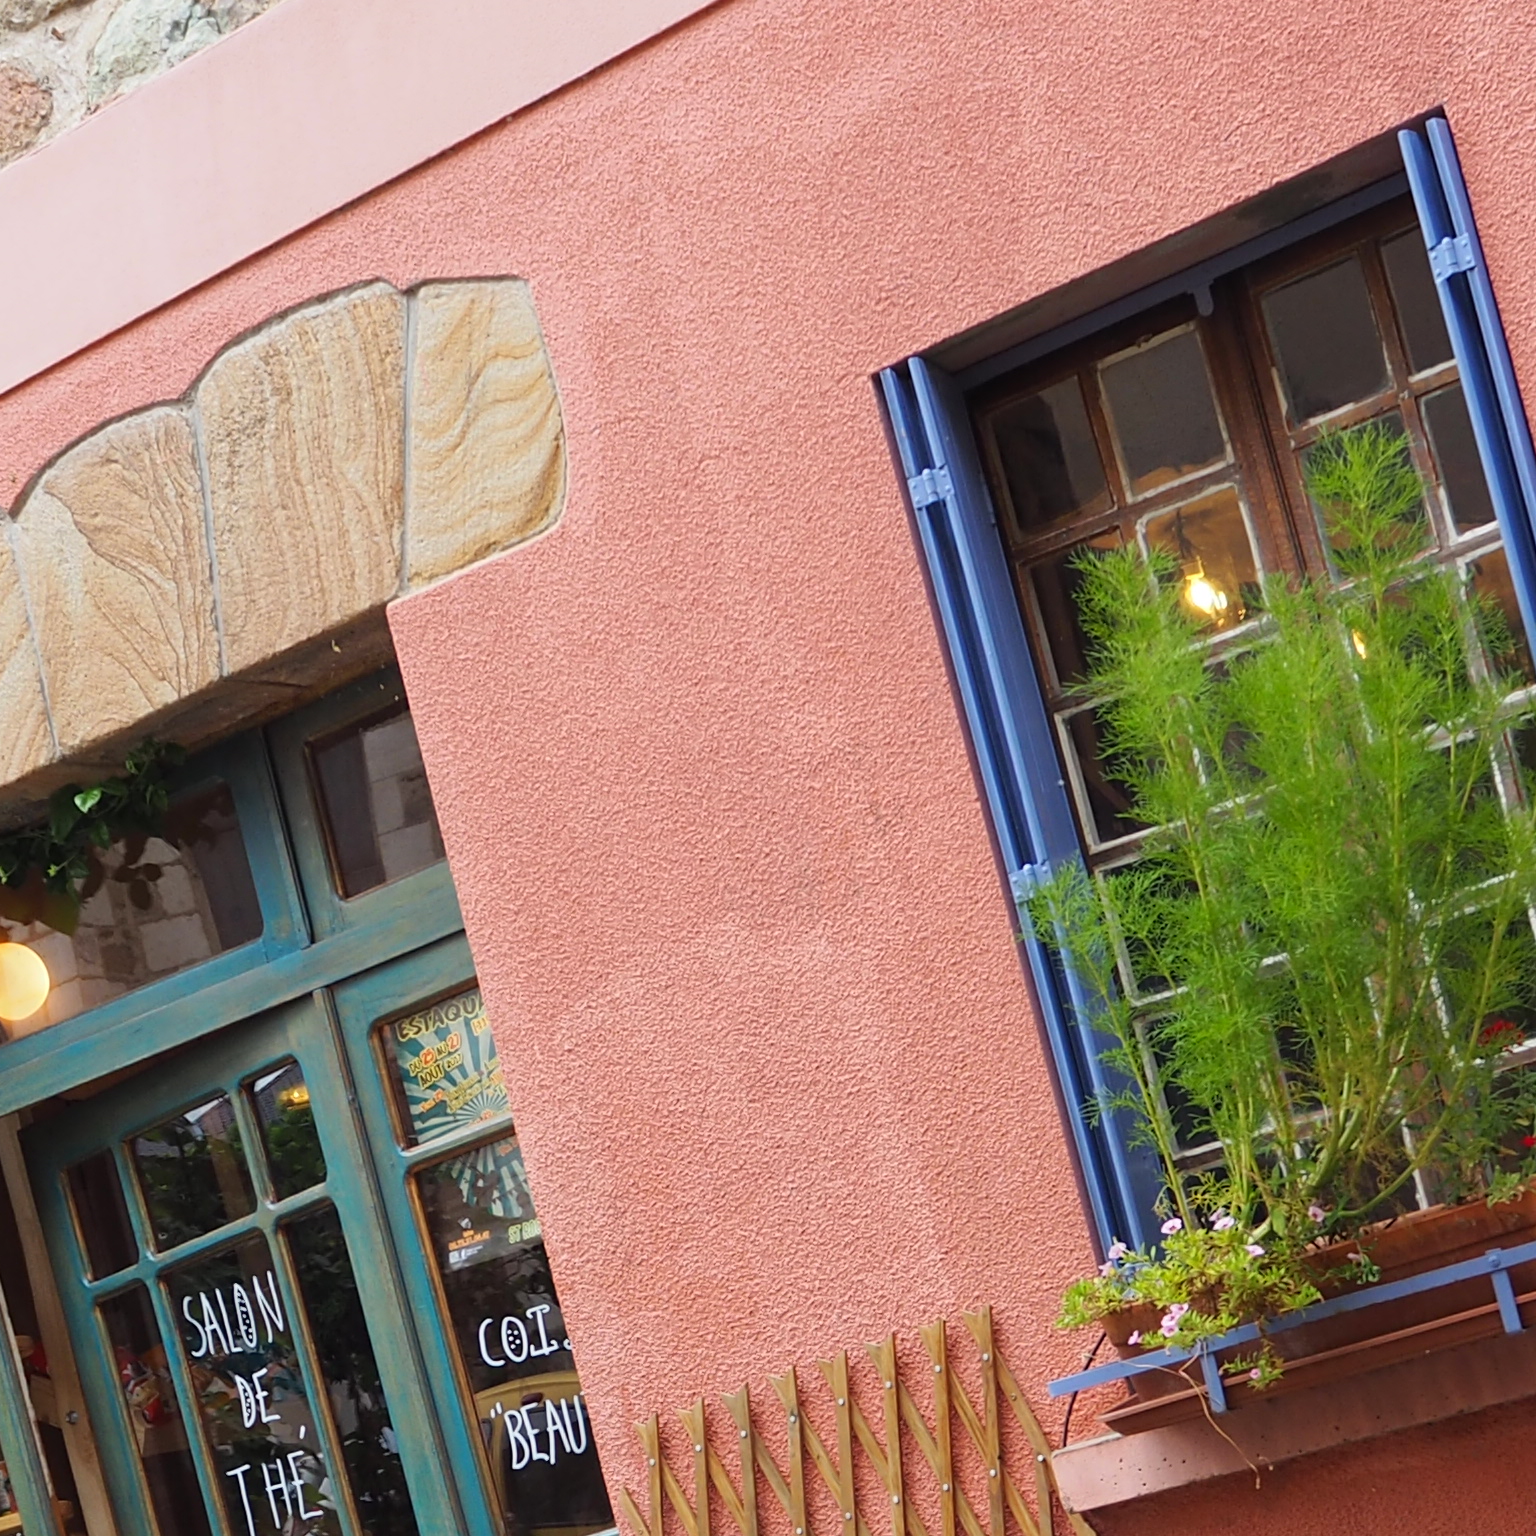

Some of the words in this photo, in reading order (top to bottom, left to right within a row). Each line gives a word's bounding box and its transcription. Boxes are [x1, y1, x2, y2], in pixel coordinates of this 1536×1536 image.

[397, 994, 484, 1038] ESTAQU
[182, 1270, 284, 1357] SALON
[478, 1304, 574, 1367] COI
[235, 1368, 281, 1428] DE
